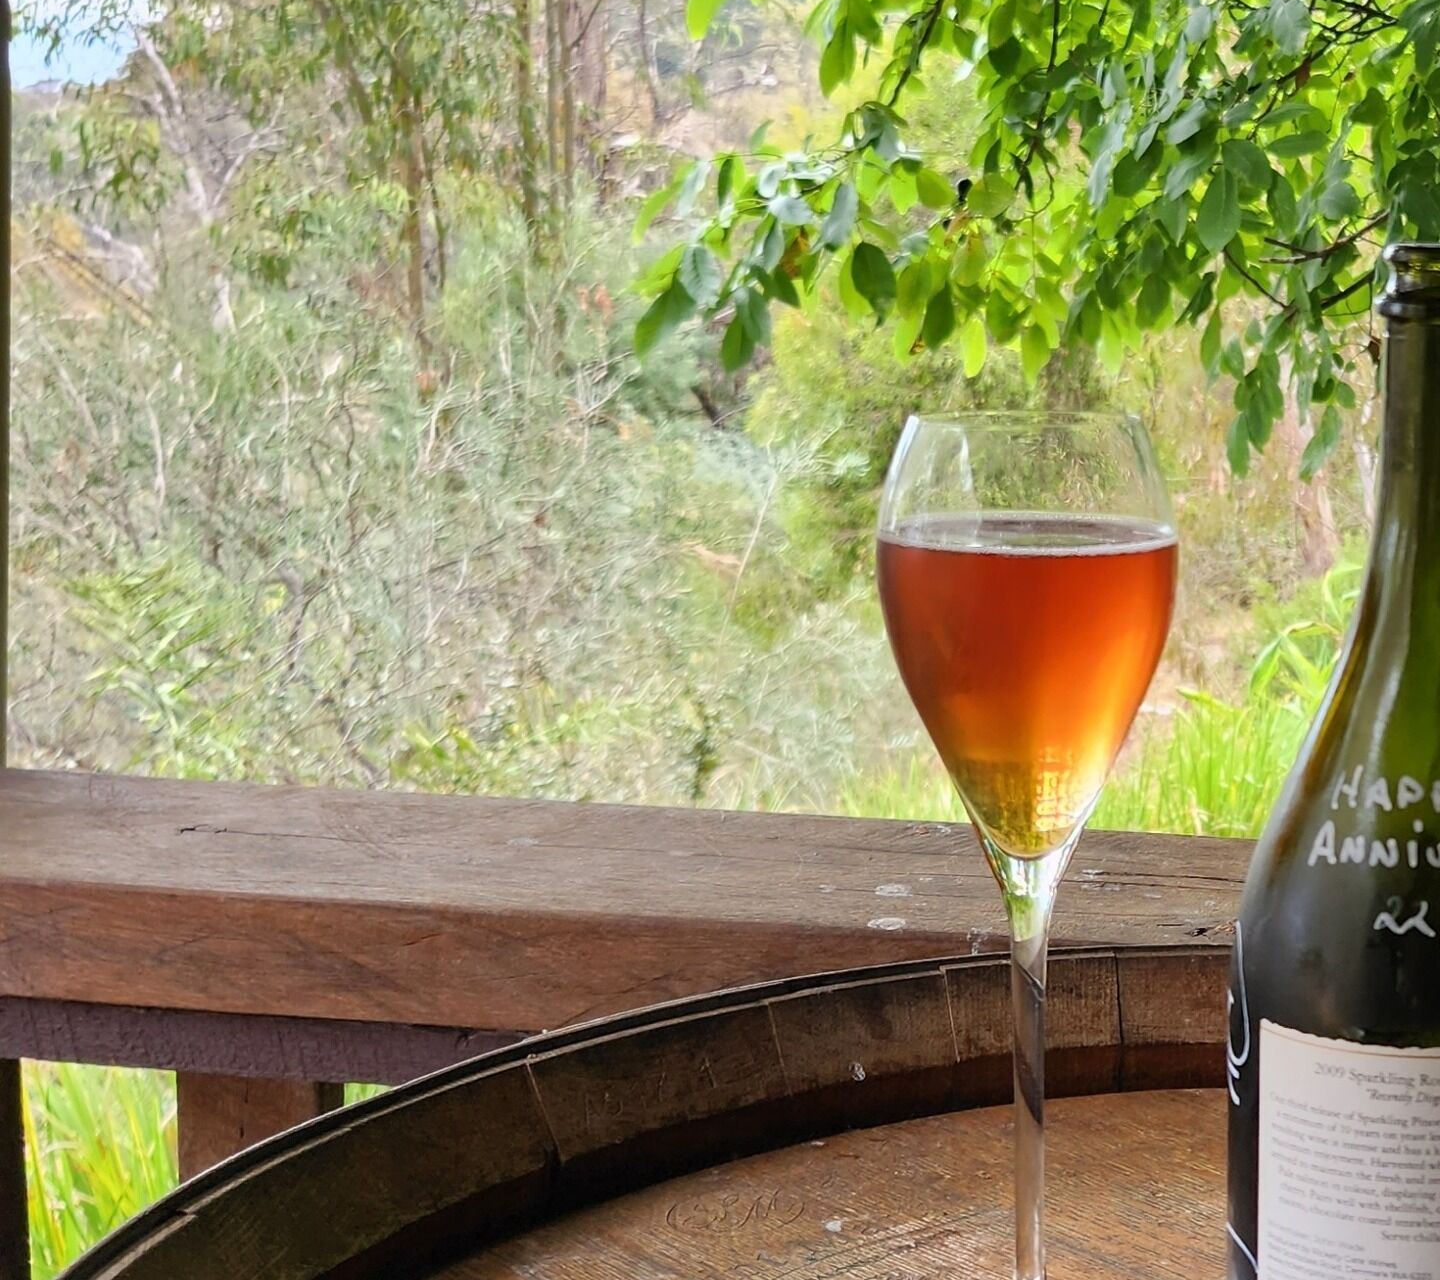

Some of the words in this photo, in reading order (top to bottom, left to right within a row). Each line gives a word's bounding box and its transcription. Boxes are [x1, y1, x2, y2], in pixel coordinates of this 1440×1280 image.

[1348, 1068, 1414, 1088] Sparkling
[1357, 1112, 1407, 1128] Sparkling
[1411, 1116, 1440, 1127] Pinot
